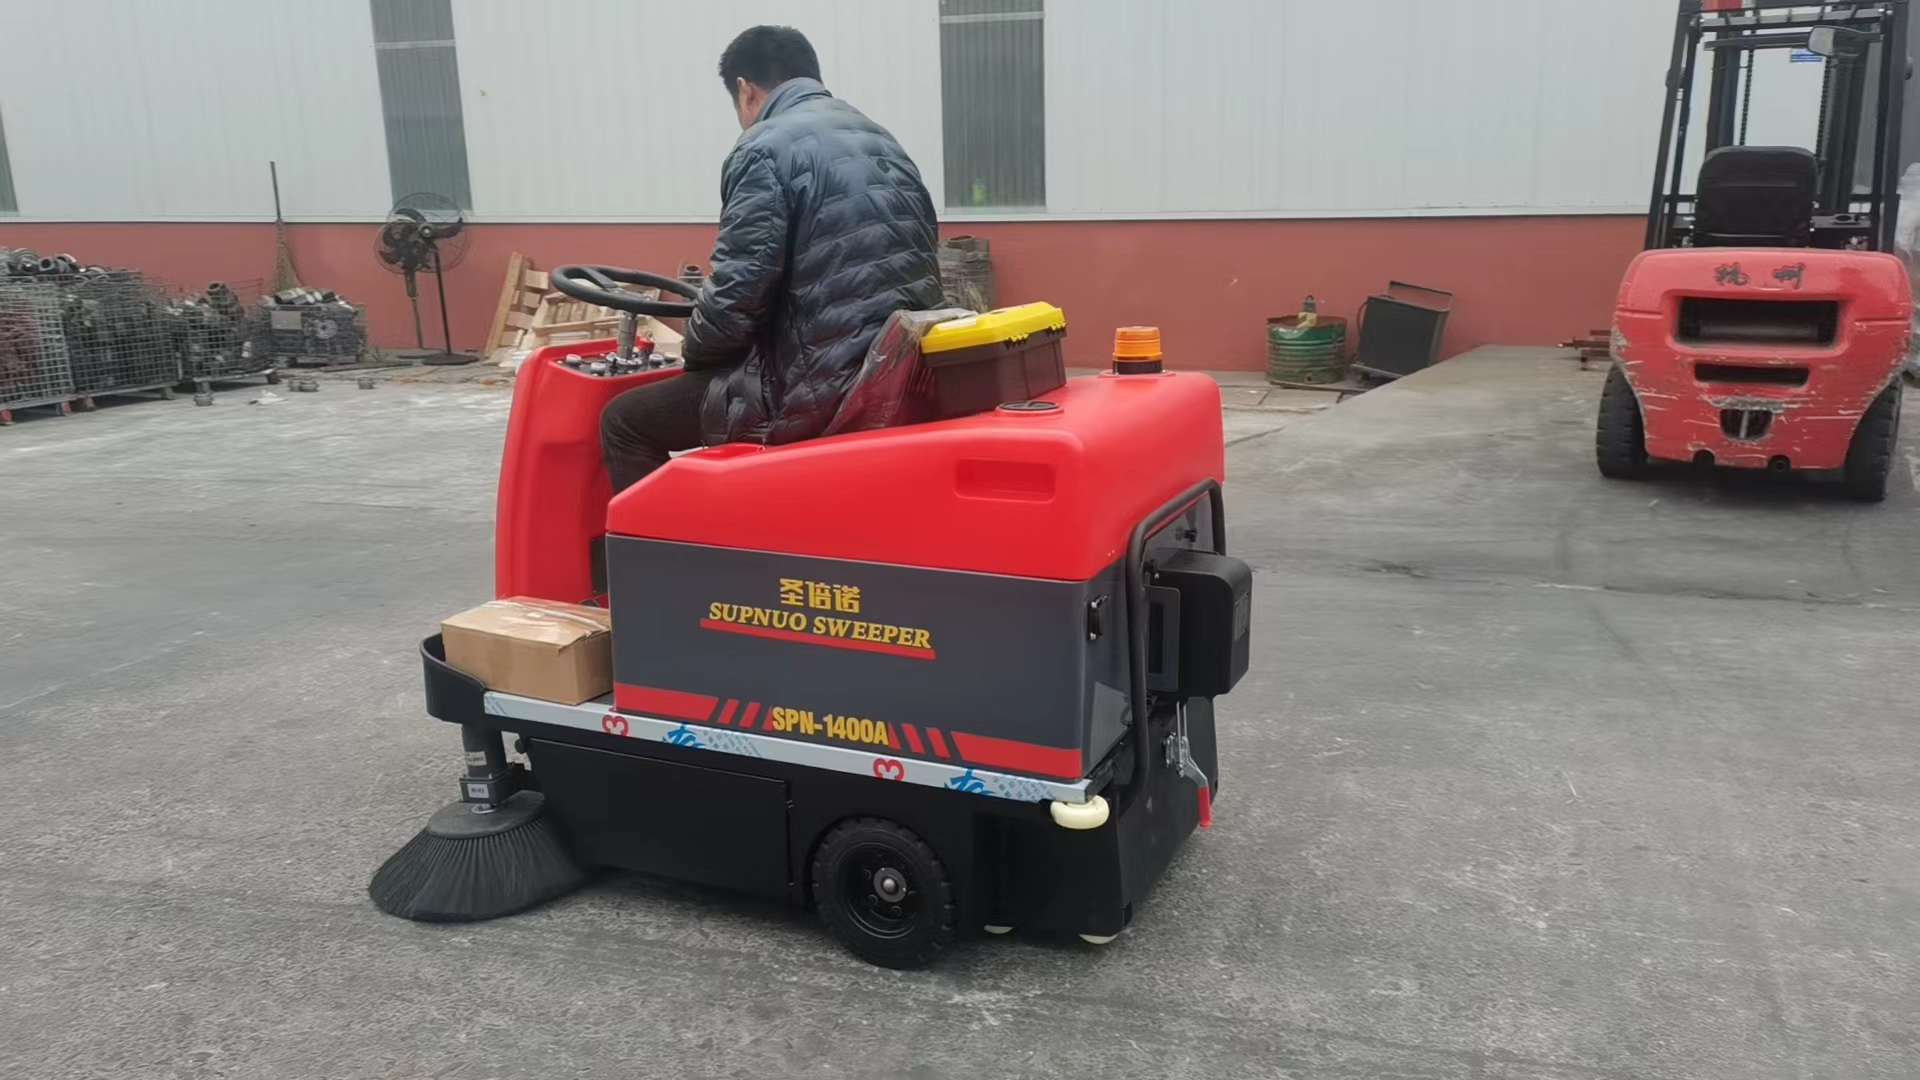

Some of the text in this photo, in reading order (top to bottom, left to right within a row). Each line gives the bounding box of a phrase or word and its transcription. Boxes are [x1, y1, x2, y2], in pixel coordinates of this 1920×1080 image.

[779, 577, 861, 614] 圣倍诺
[708, 602, 932, 649] SUPNUO SWEEPER
[772, 706, 890, 746] SPN-1400A
